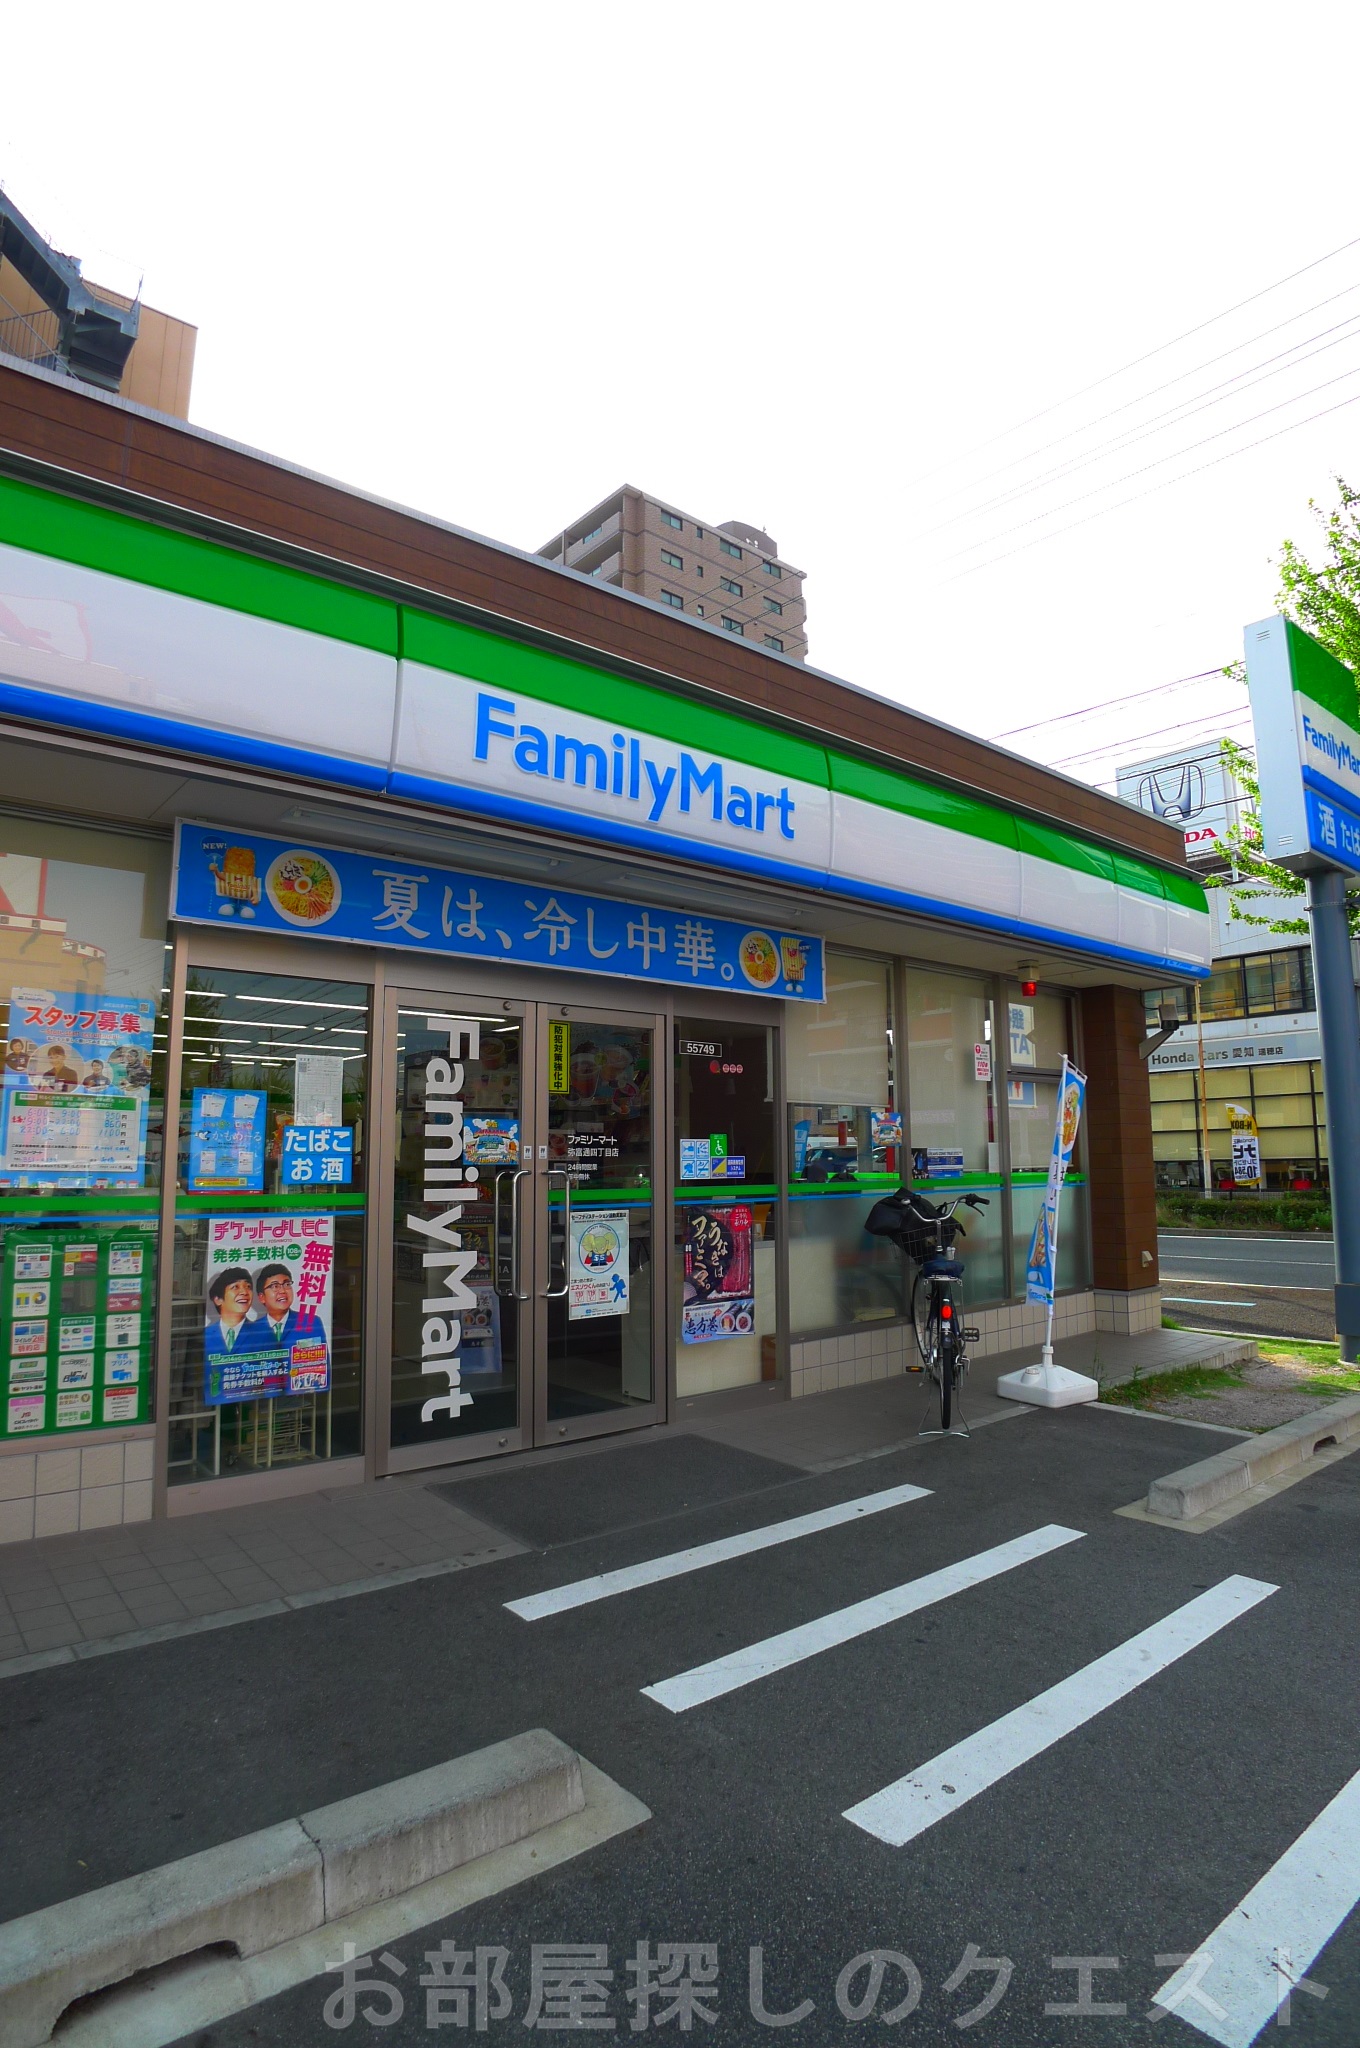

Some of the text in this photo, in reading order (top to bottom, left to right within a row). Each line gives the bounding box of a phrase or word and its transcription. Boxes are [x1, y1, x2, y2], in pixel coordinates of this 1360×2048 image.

[473, 691, 795, 840] FamilyMart
[1318, 801, 1338, 849] 酒
[202, 842, 228, 850] NEW!
[371, 868, 735, 982] 夏は、冷し中華。
[24, 1005, 141, 1034] スタッフ募集
[553, 1025, 563, 1090] 防犯対策強化中
[686, 1042, 715, 1055] 55749
[1151, 1052, 1195, 1065] Honda
[1232, 1046, 1254, 1058] 愛知
[285, 1128, 351, 1153] たばこ
[567, 1135, 617, 1146] ファミリーマート
[567, 1147, 619, 1158] 弥富通四丁目店
[290, 1157, 344, 1182] お酒
[567, 1163, 598, 1171] 24時間営業
[214, 1218, 329, 1241] チケットよしもと
[407, 1018, 480, 1422] FamilyMart
[213, 1245, 286, 1264] 発券手数料
[708, 1221, 729, 1278] うなぎは
